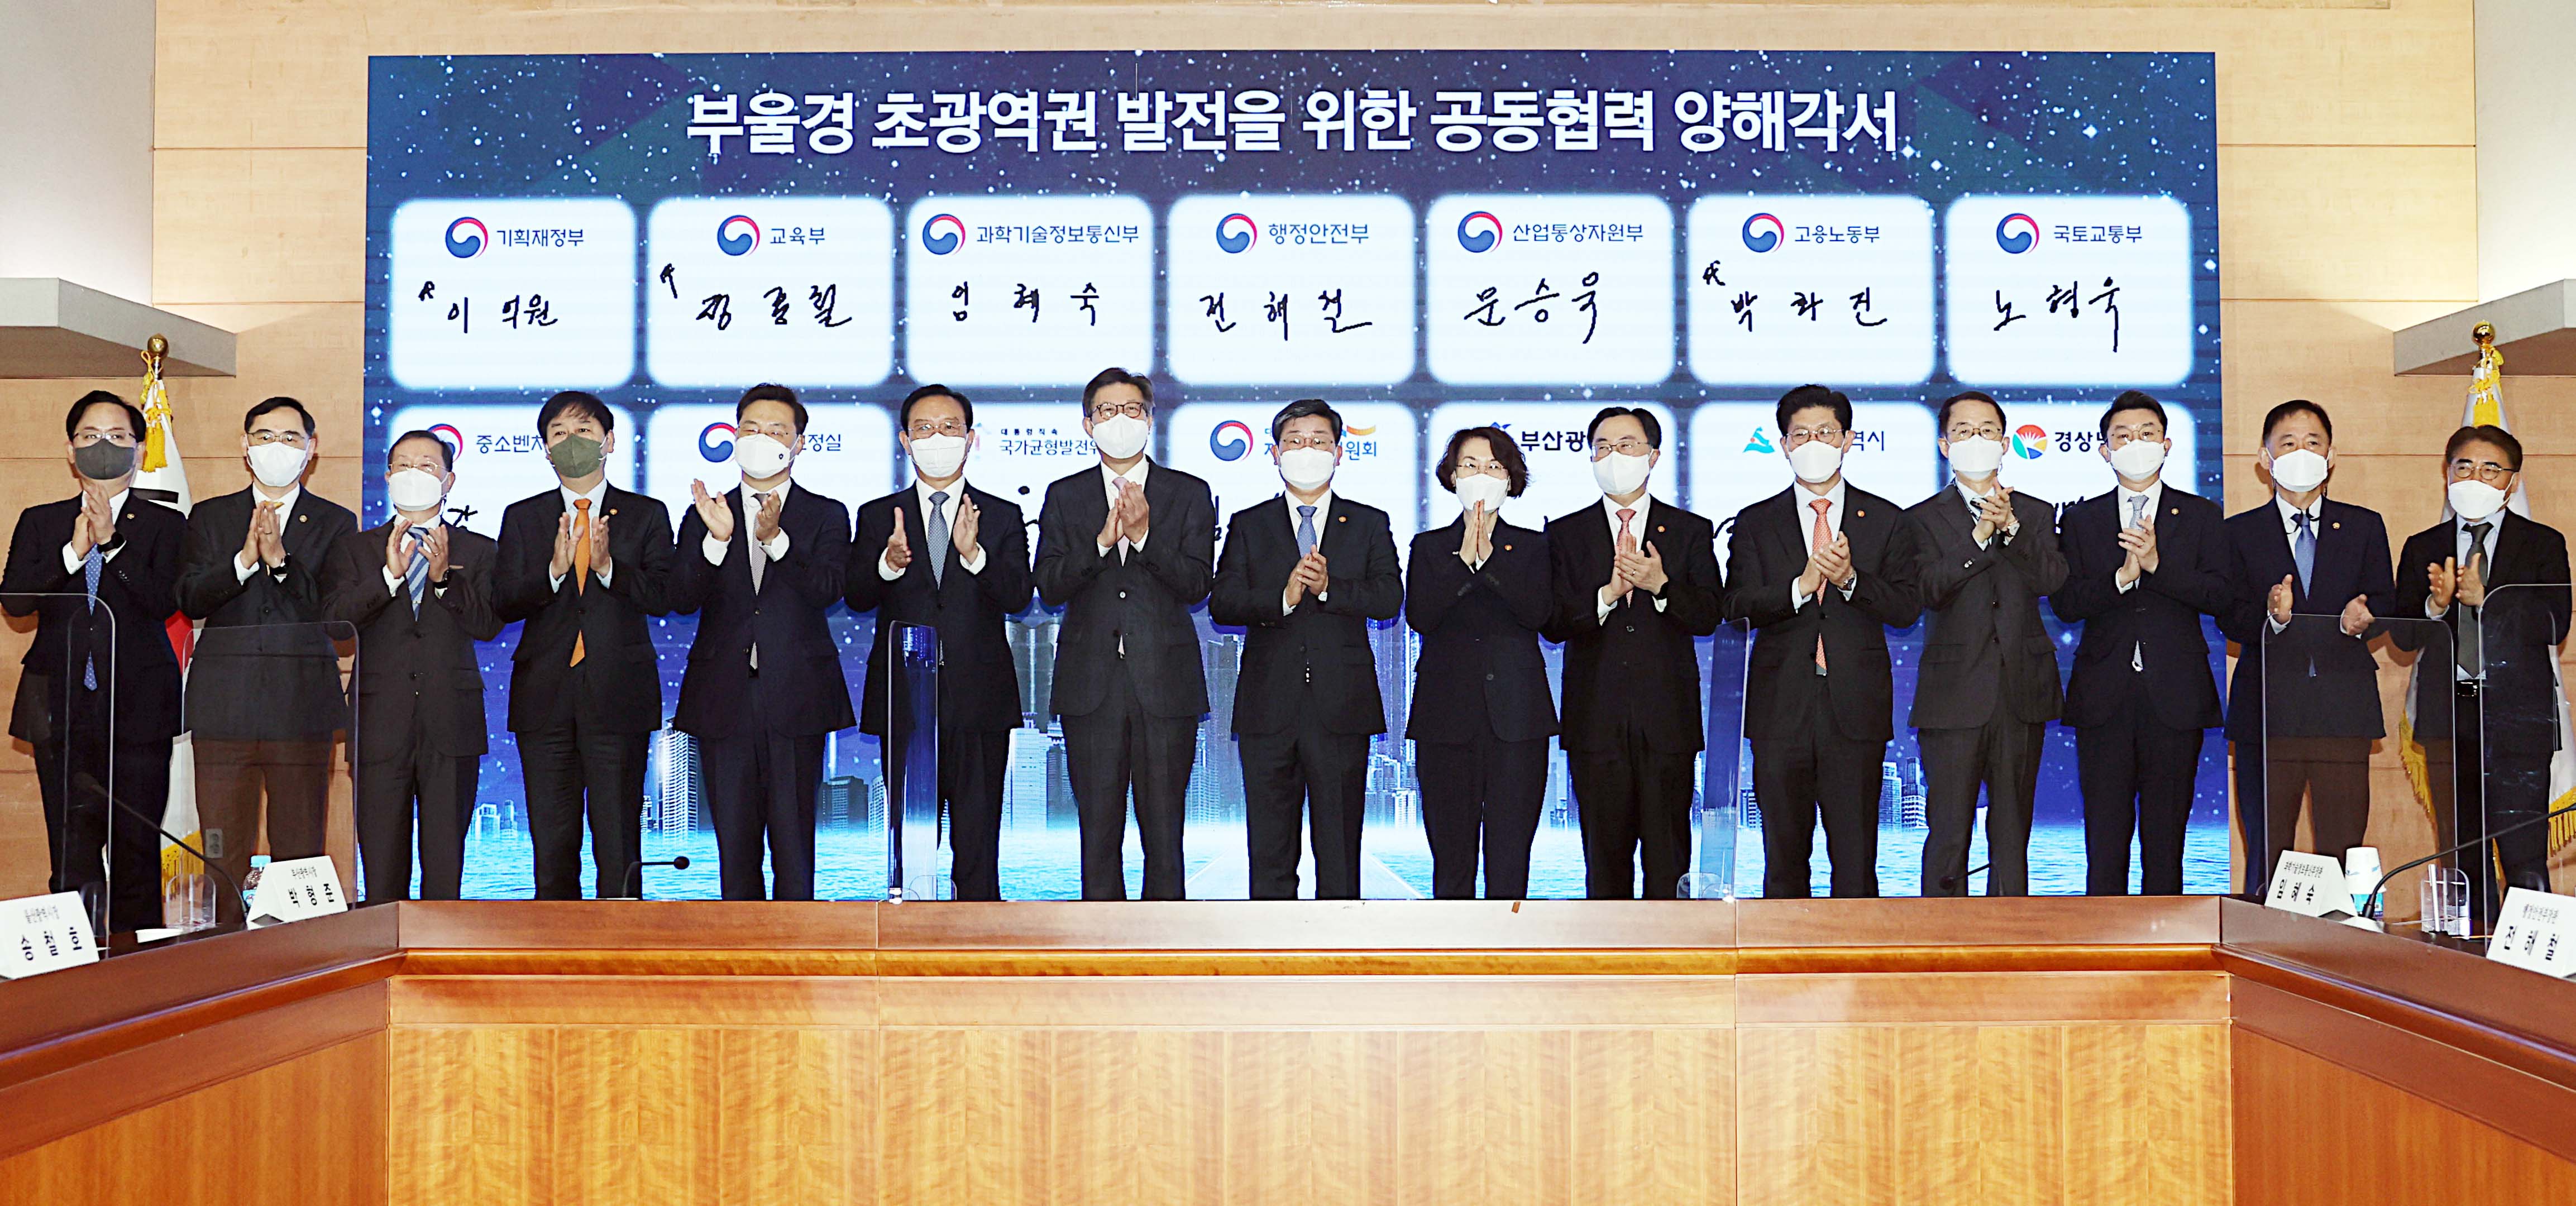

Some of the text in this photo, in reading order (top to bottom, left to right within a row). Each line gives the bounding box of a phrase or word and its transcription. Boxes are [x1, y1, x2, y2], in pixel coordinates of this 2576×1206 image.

[687, 89, 1895, 154] 부울경 초광역권 발전을 위한 공동협력 양해각서
[497, 229, 584, 247] 기획재정부
[770, 227, 825, 245] 교육부
[977, 226, 1138, 243] 과학기술정보통신부
[1269, 224, 1368, 244] 행정안전부
[1513, 224, 1643, 242] 산업통상자원부
[1795, 226, 1880, 243] 고용노동부
[2054, 226, 2142, 243] 국토교통부
[801, 434, 841, 452] 정실
